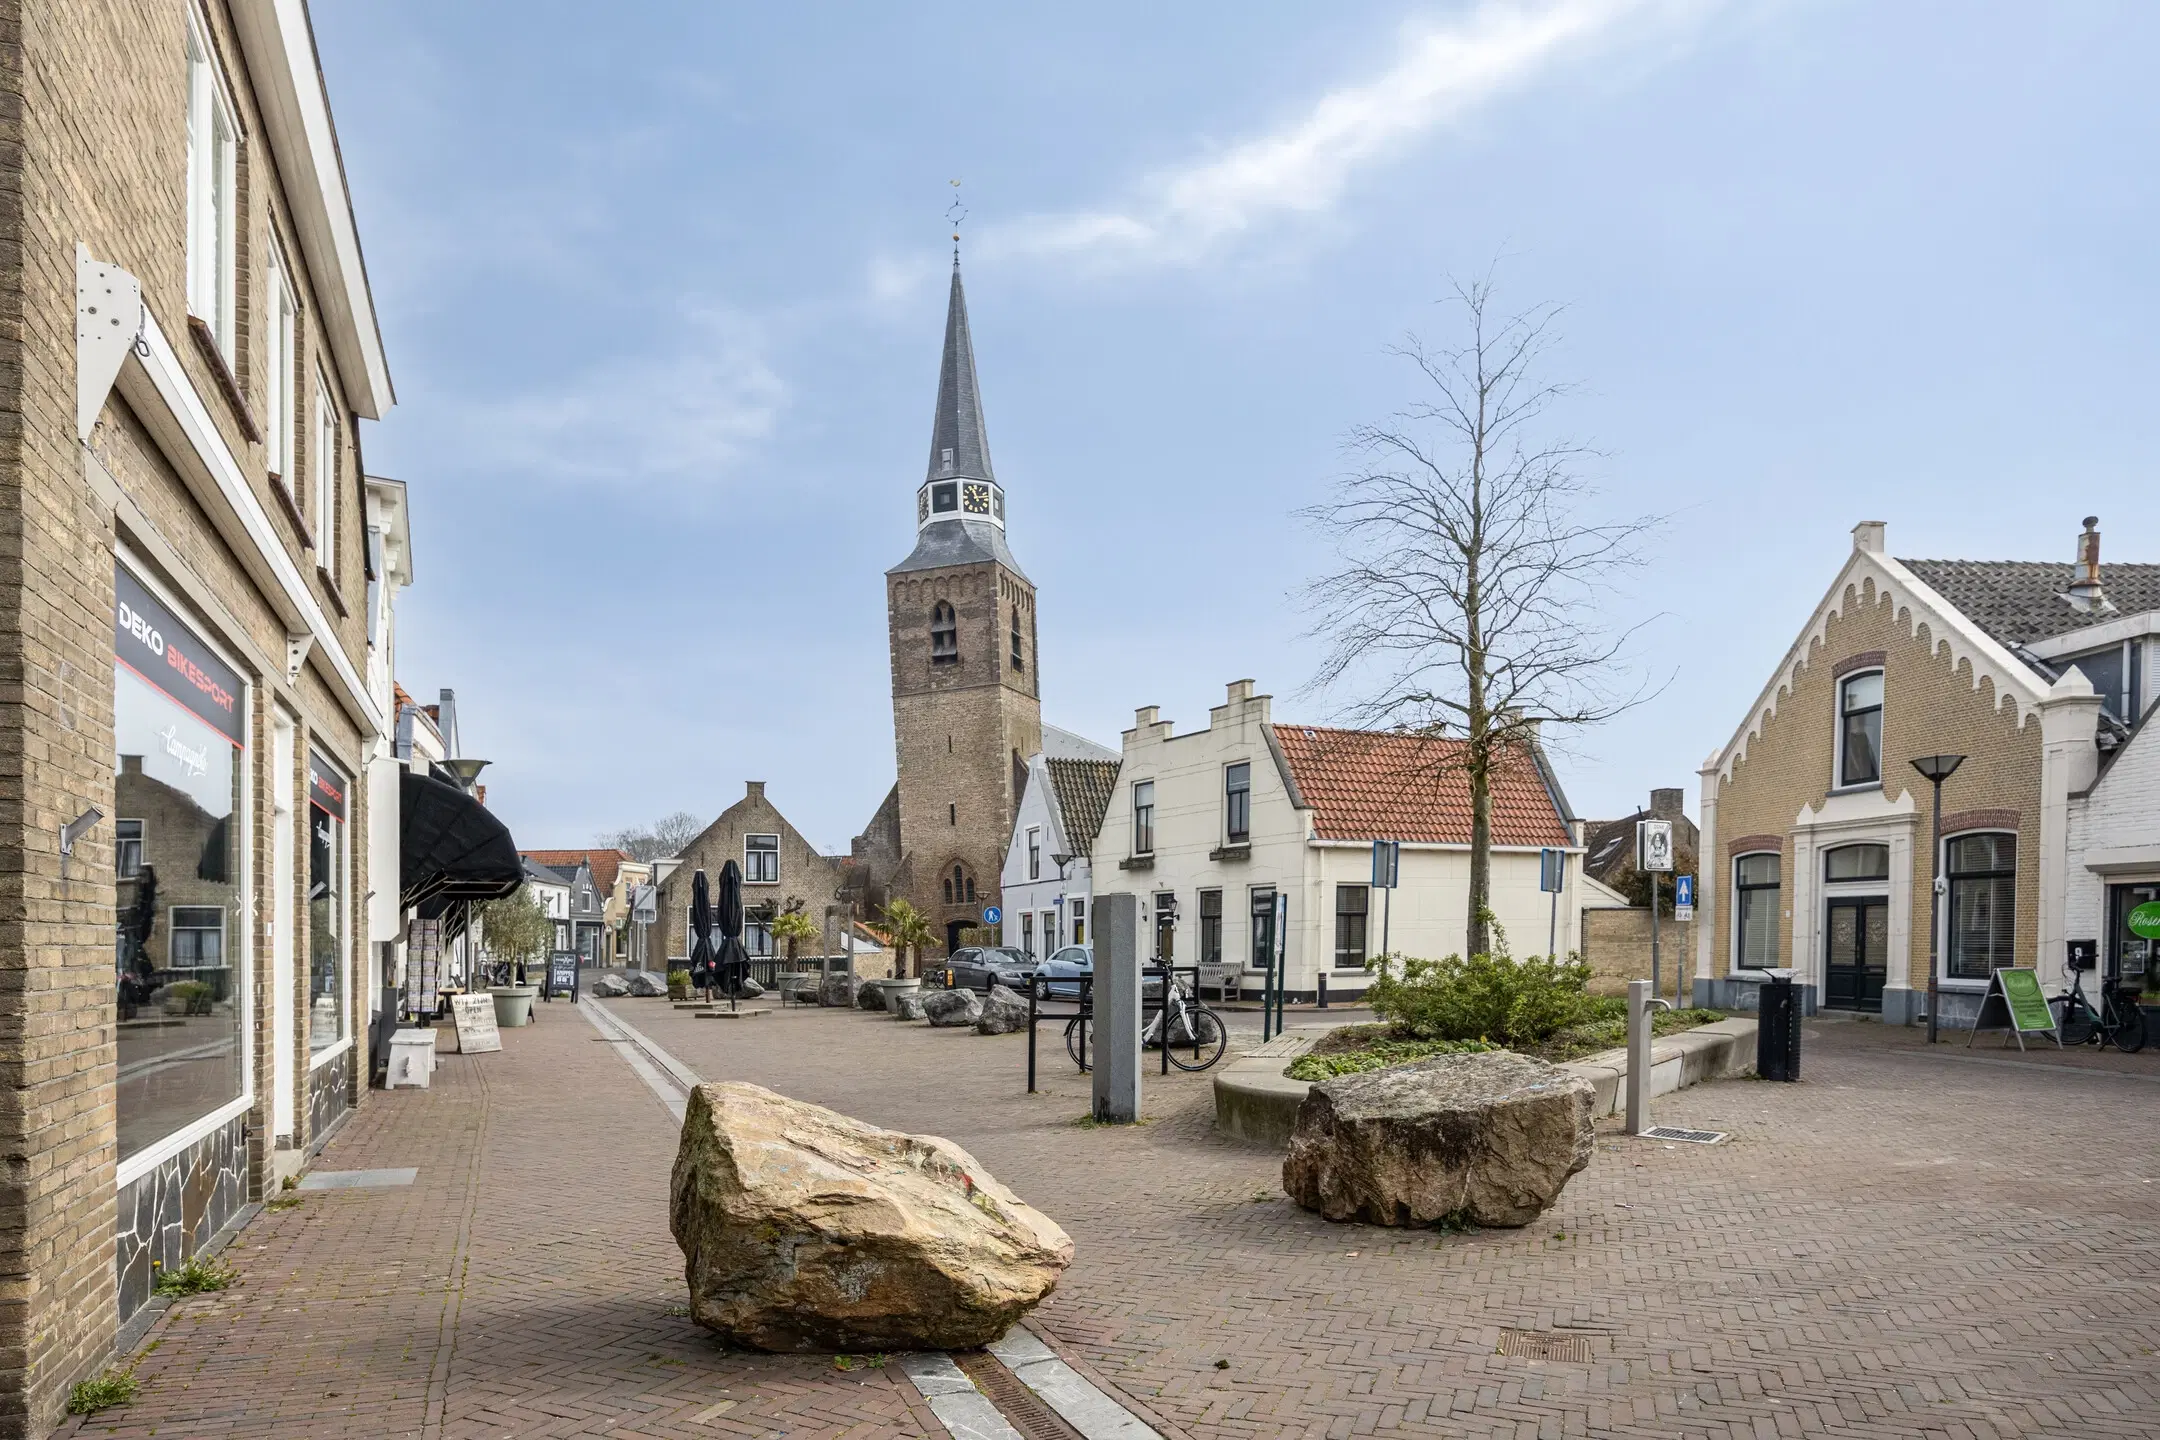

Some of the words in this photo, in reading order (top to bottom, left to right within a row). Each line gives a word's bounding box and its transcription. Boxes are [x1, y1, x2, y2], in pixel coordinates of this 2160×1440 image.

[119, 601, 164, 656] DEKO
[167, 643, 235, 713] BIKESPORT
[2074, 947, 2083, 960] 9
